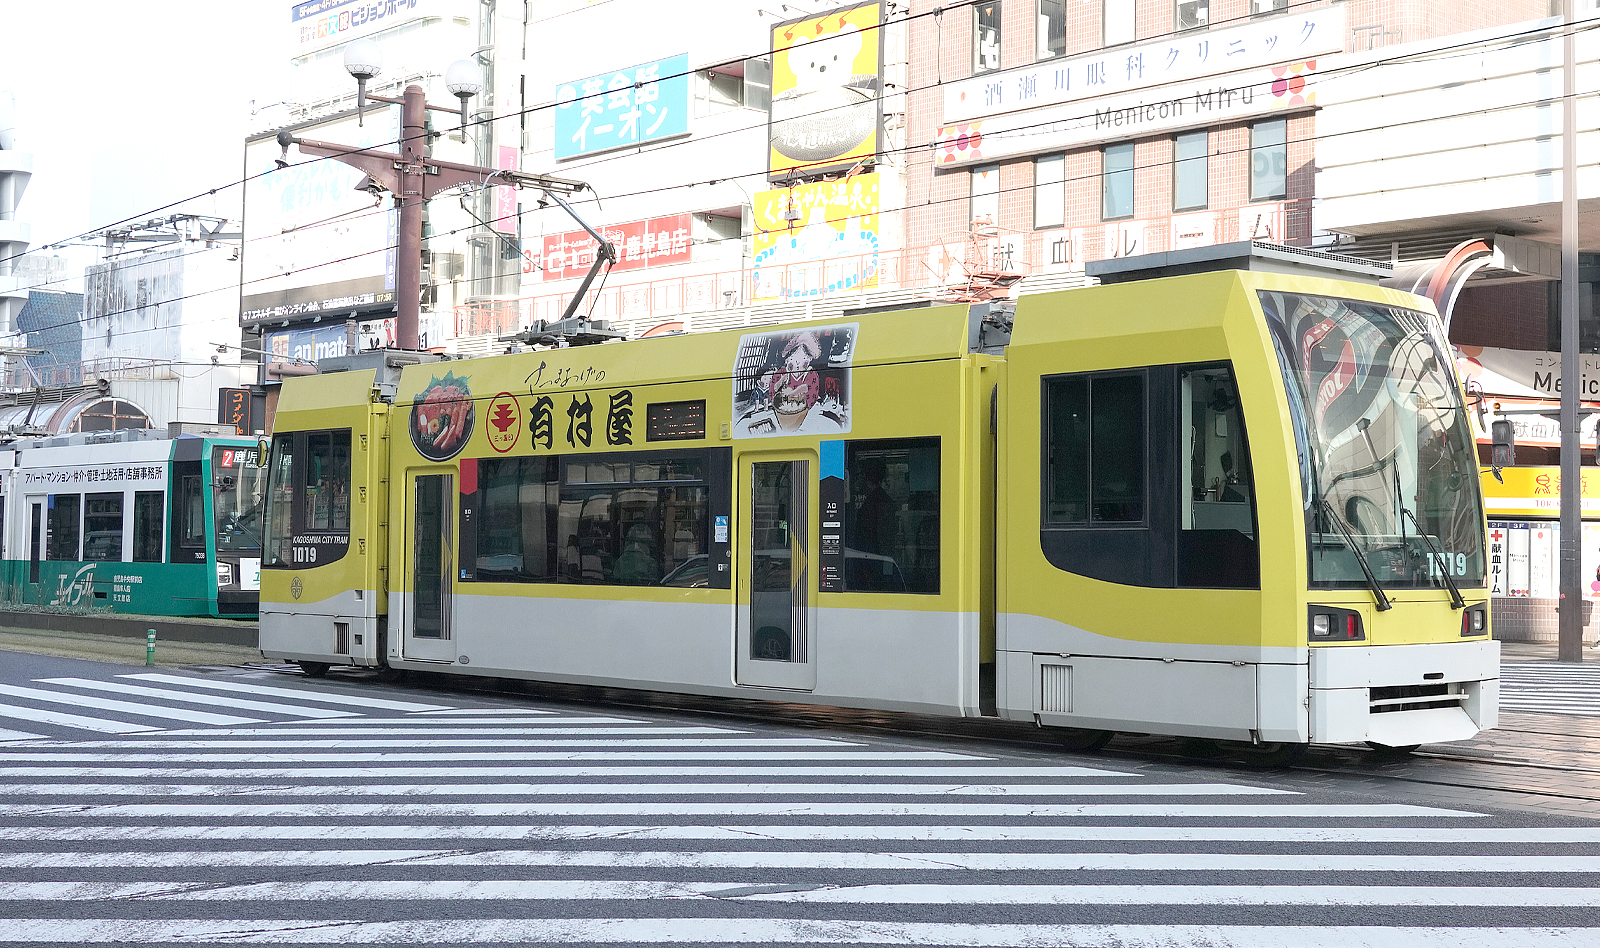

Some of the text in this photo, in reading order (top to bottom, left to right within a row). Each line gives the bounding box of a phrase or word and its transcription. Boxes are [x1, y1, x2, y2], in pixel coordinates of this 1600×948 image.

[581, 63, 659, 118] 英会話
[572, 104, 668, 152] イーオン
[1096, 98, 1184, 130] Menicon
[764, 182, 867, 224] くまちゃん温泉
[1534, 371, 1600, 394] Meic
[529, 390, 634, 450] 有村屋
[224, 451, 233, 466] 2
[293, 547, 317, 562] 1019
[1491, 543, 1502, 593] 献血ルーム
